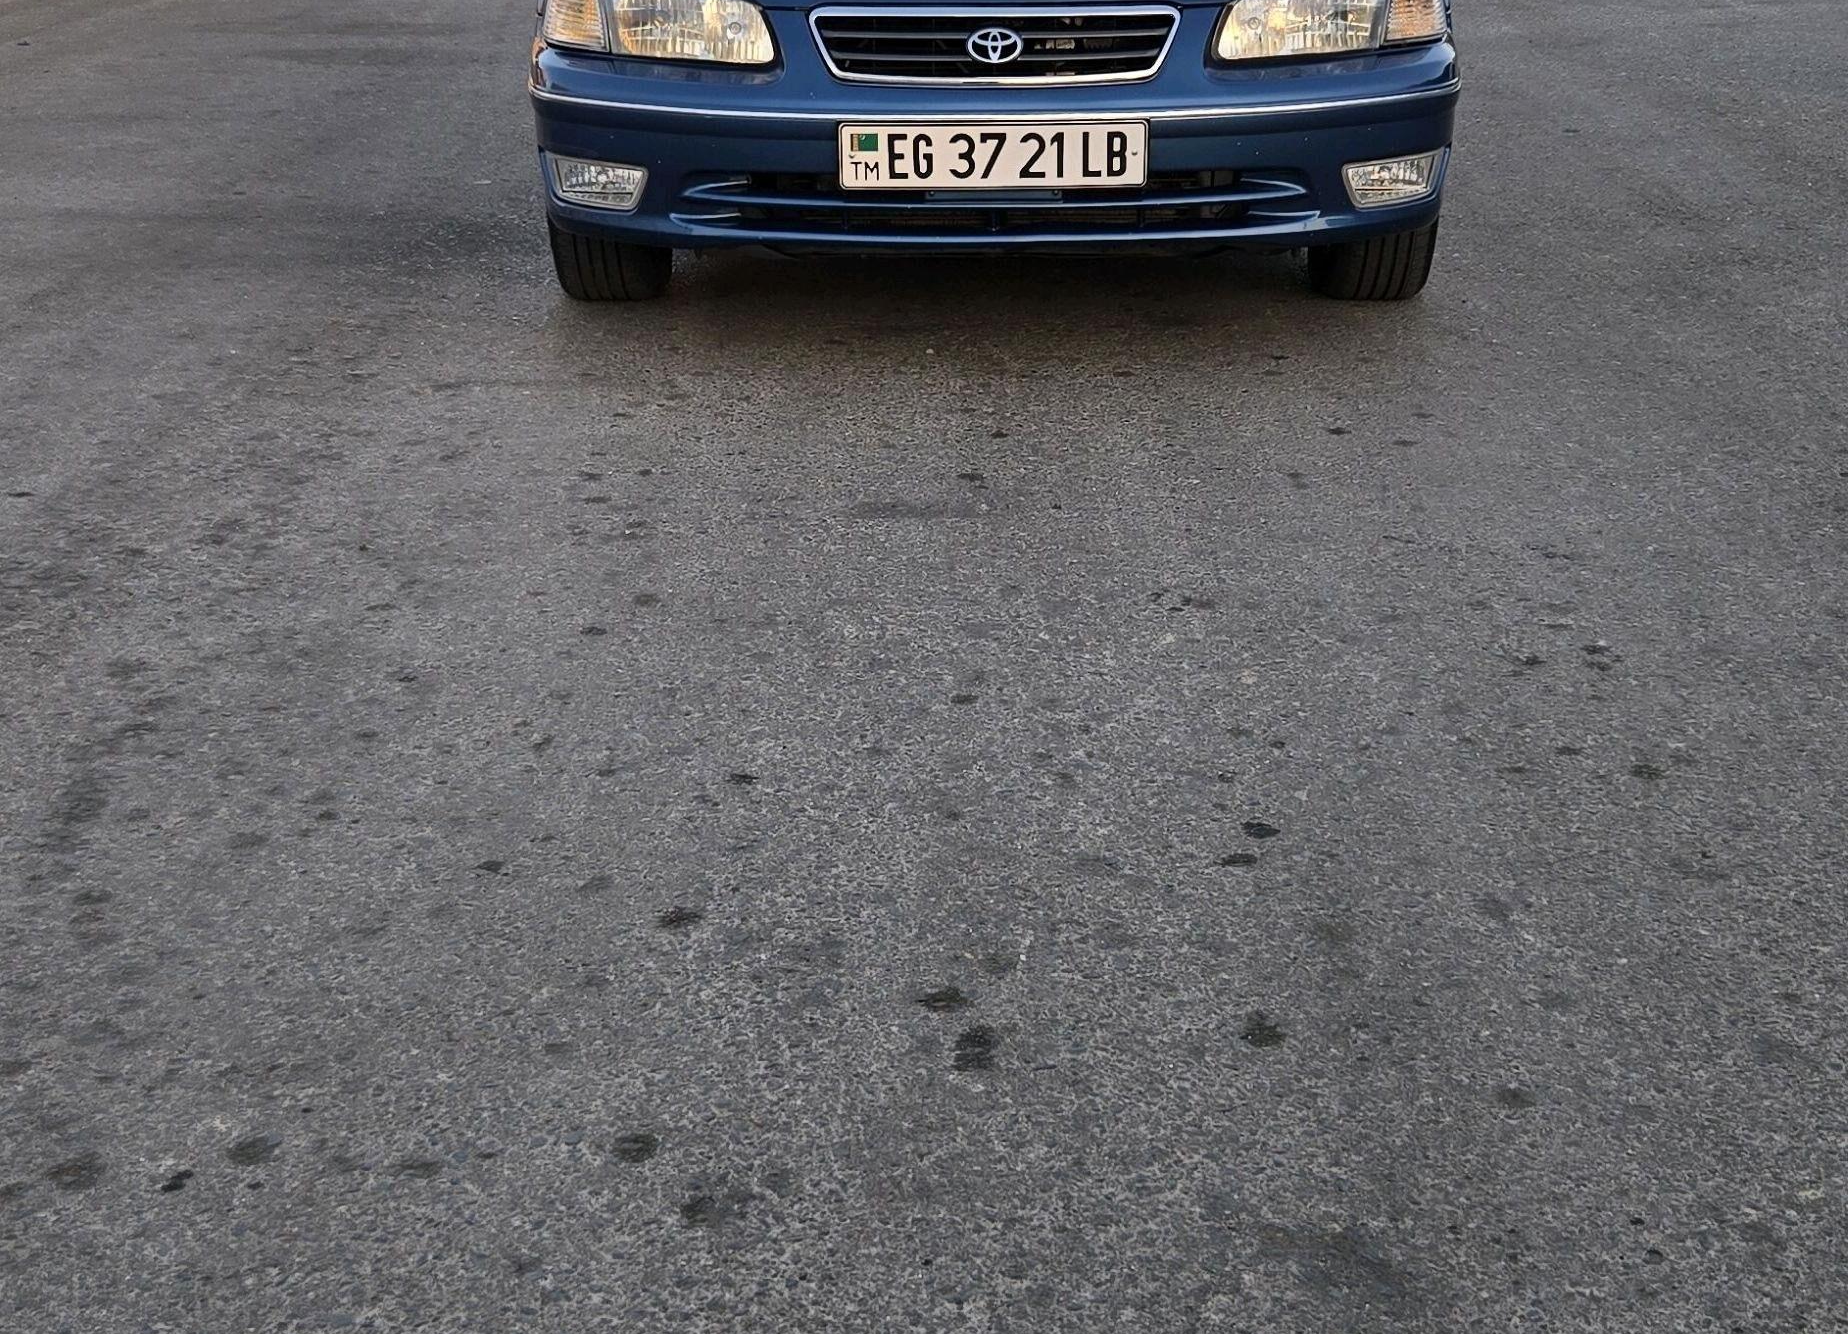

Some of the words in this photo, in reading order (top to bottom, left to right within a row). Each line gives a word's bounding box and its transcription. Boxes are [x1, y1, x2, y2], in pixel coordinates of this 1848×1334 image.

[850, 161, 880, 181] TM
[887, 133, 933, 180] EG
[949, 133, 1007, 179] 37
[1019, 132, 1064, 179] 21
[1082, 131, 1128, 178] LB
